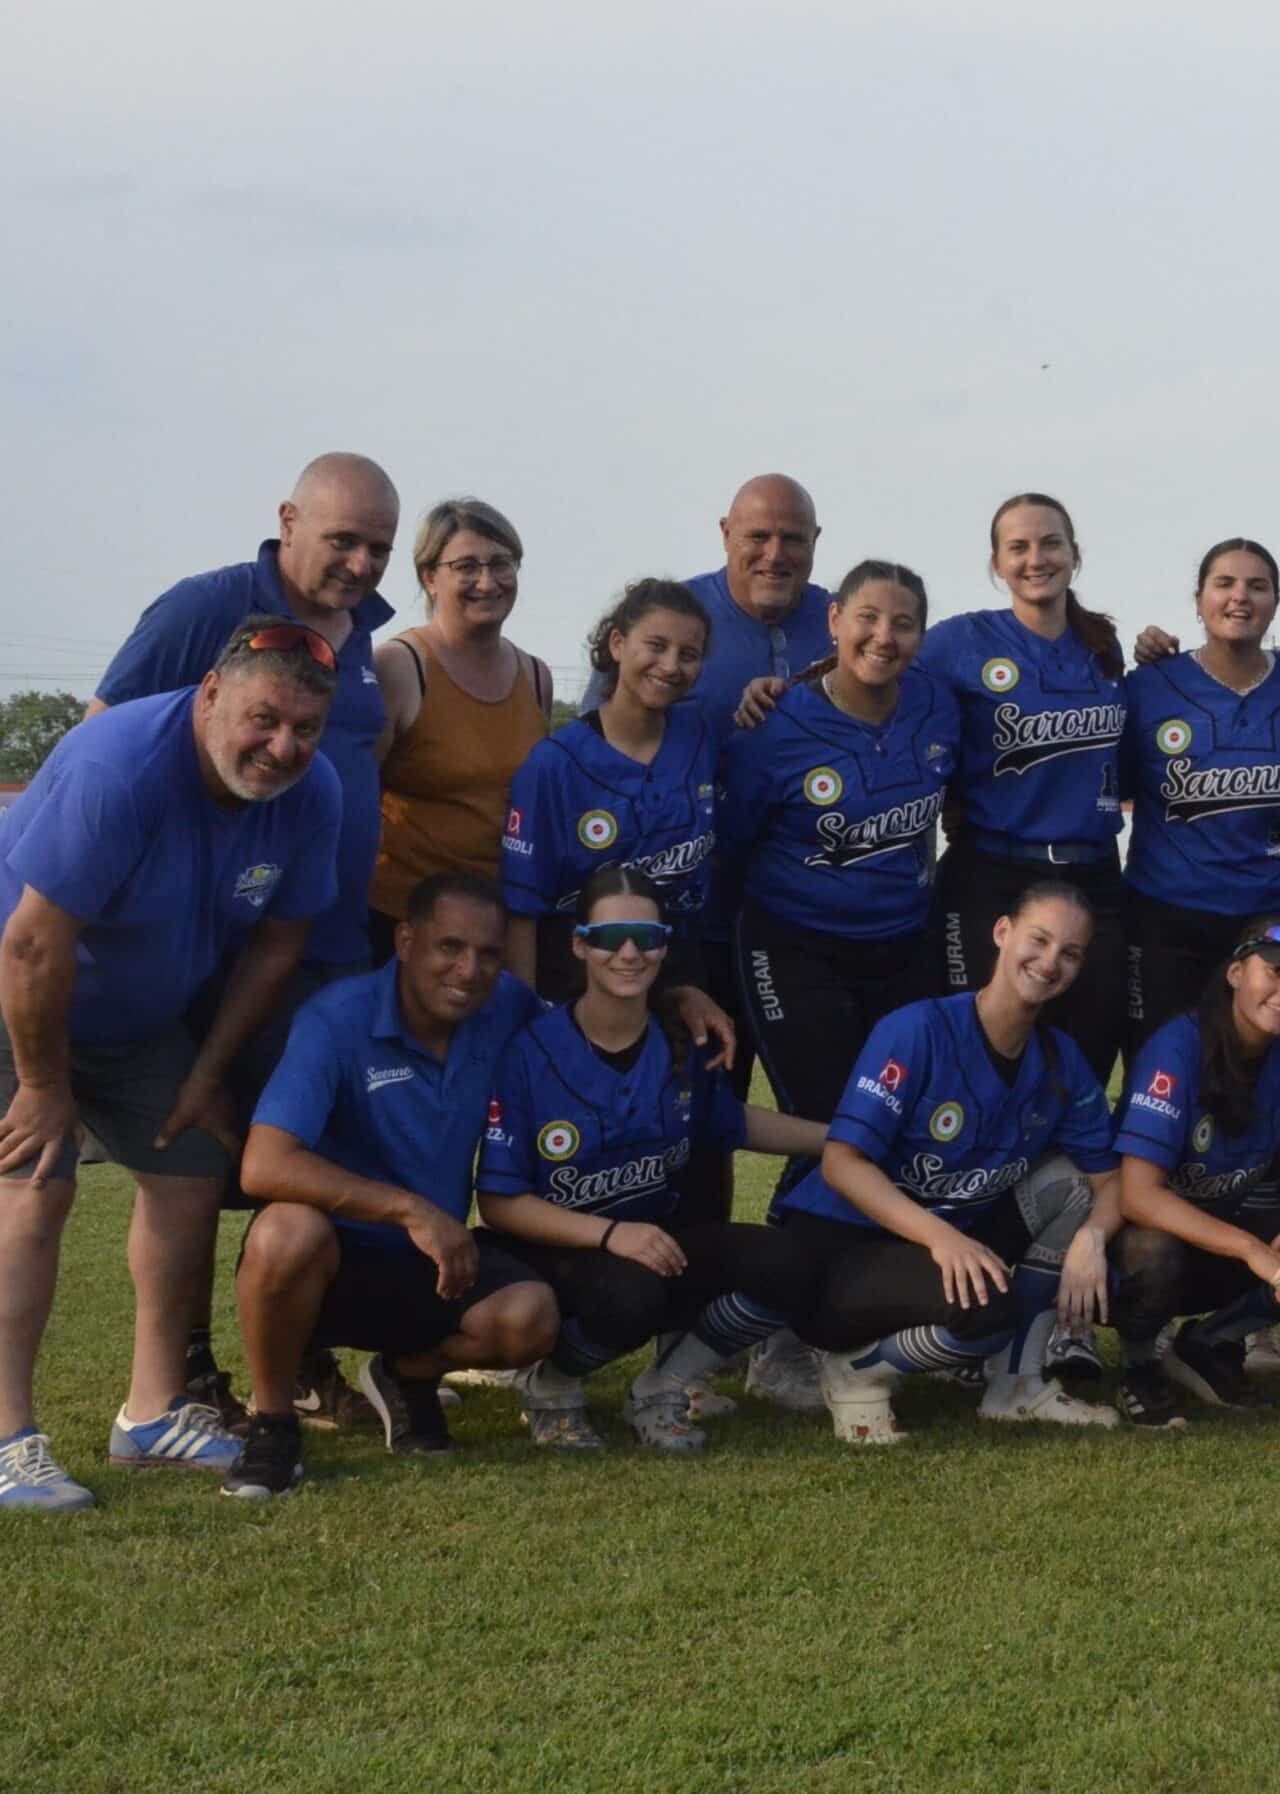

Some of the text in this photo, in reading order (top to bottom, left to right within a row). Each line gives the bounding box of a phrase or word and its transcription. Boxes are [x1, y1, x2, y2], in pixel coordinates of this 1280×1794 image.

[816, 786, 947, 852] Saronn
[946, 911, 968, 985] EURAM
[752, 950, 784, 1021] EURAM
